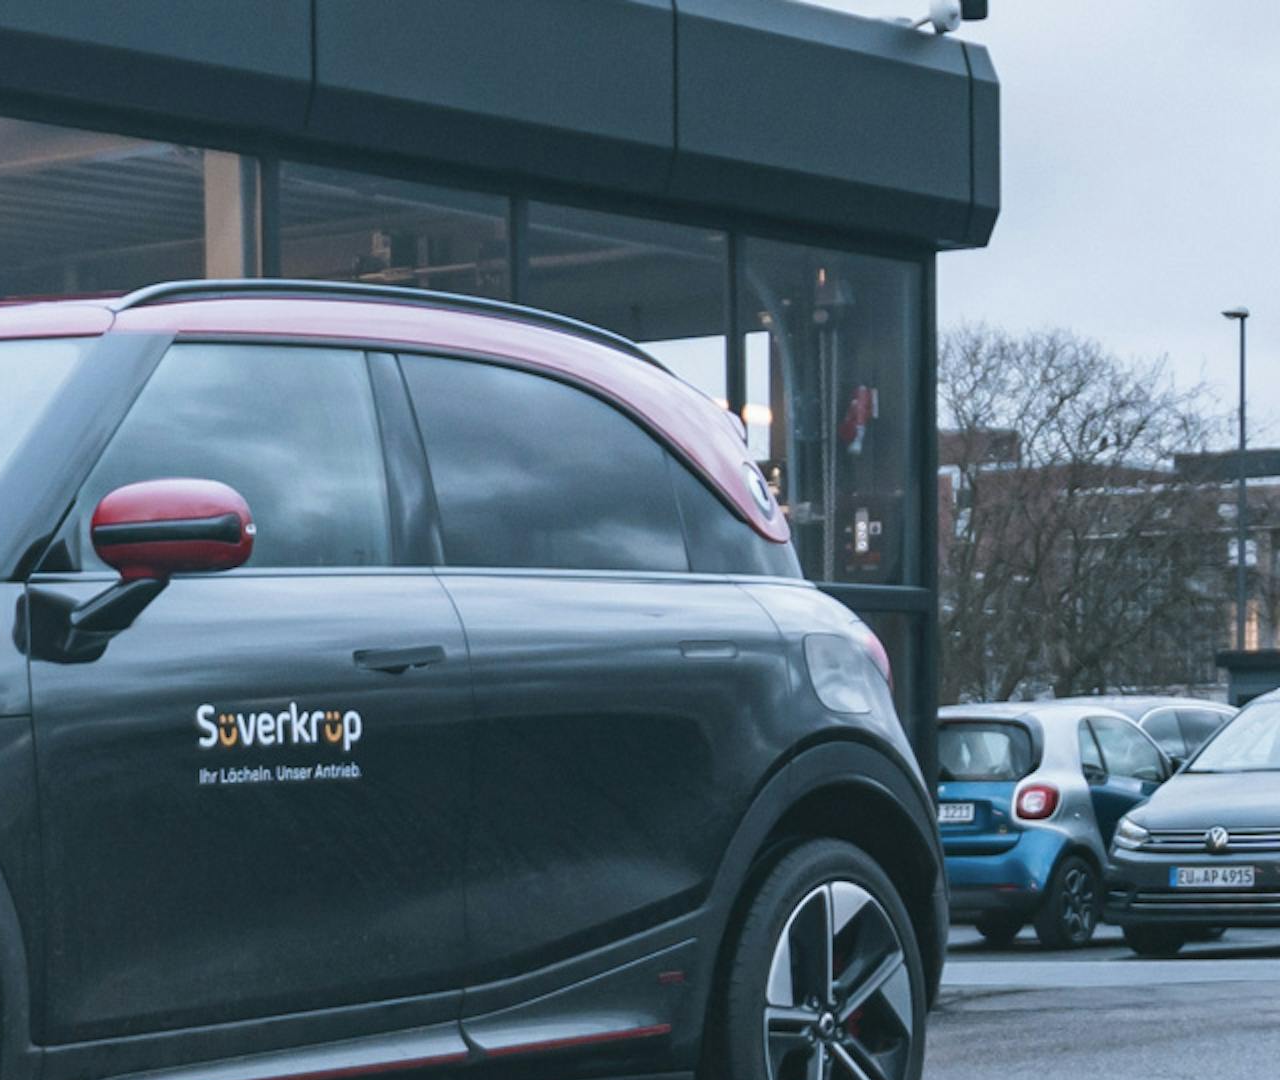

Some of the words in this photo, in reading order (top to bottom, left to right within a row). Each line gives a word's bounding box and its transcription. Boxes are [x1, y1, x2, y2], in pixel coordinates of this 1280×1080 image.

[196, 701, 362, 751] Süverkrüp
[198, 768, 218, 785] Ihr
[276, 765, 312, 781] Unser
[314, 760, 362, 779] Antrieb.
[1203, 869, 1218, 884] AP
